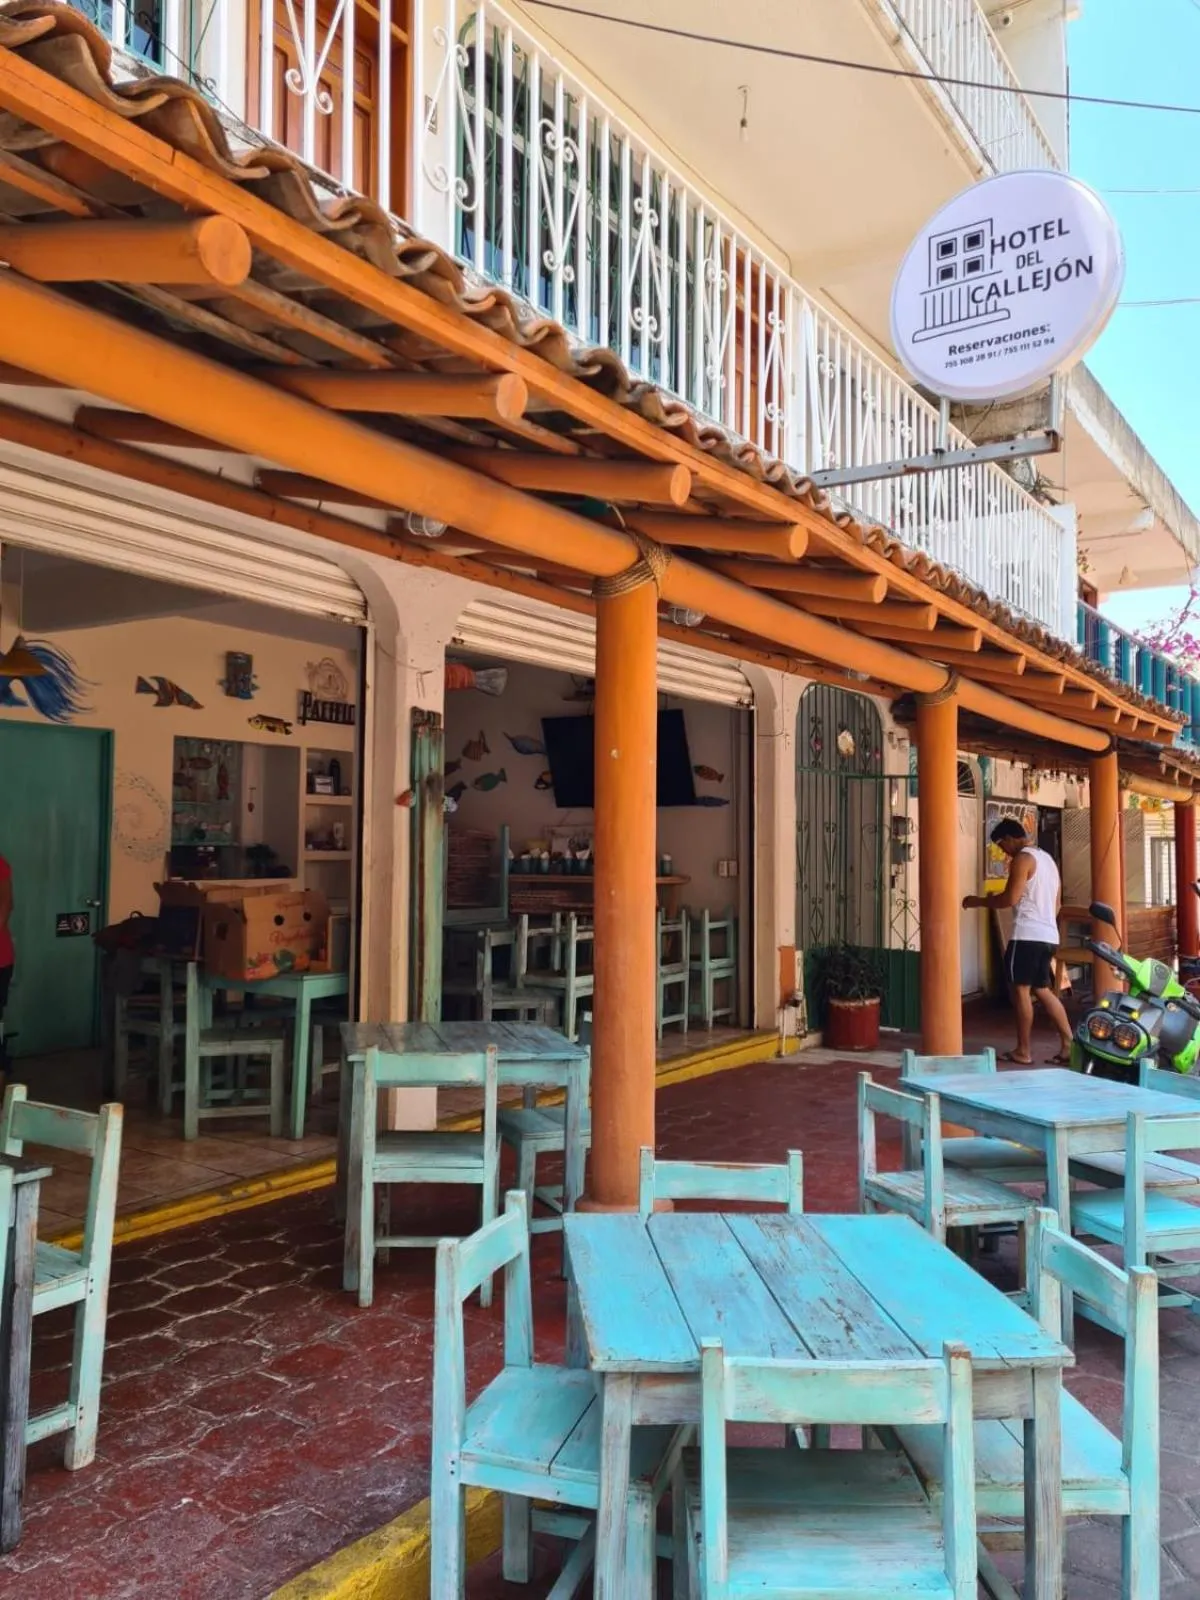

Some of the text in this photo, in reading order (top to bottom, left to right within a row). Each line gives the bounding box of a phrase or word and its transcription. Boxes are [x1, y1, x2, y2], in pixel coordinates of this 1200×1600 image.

[991, 218, 1070, 256] HOTEL
[1016, 250, 1044, 270] DEL
[971, 255, 1094, 304] CALLEJÓN
[948, 323, 1051, 356] Reservaciones:
